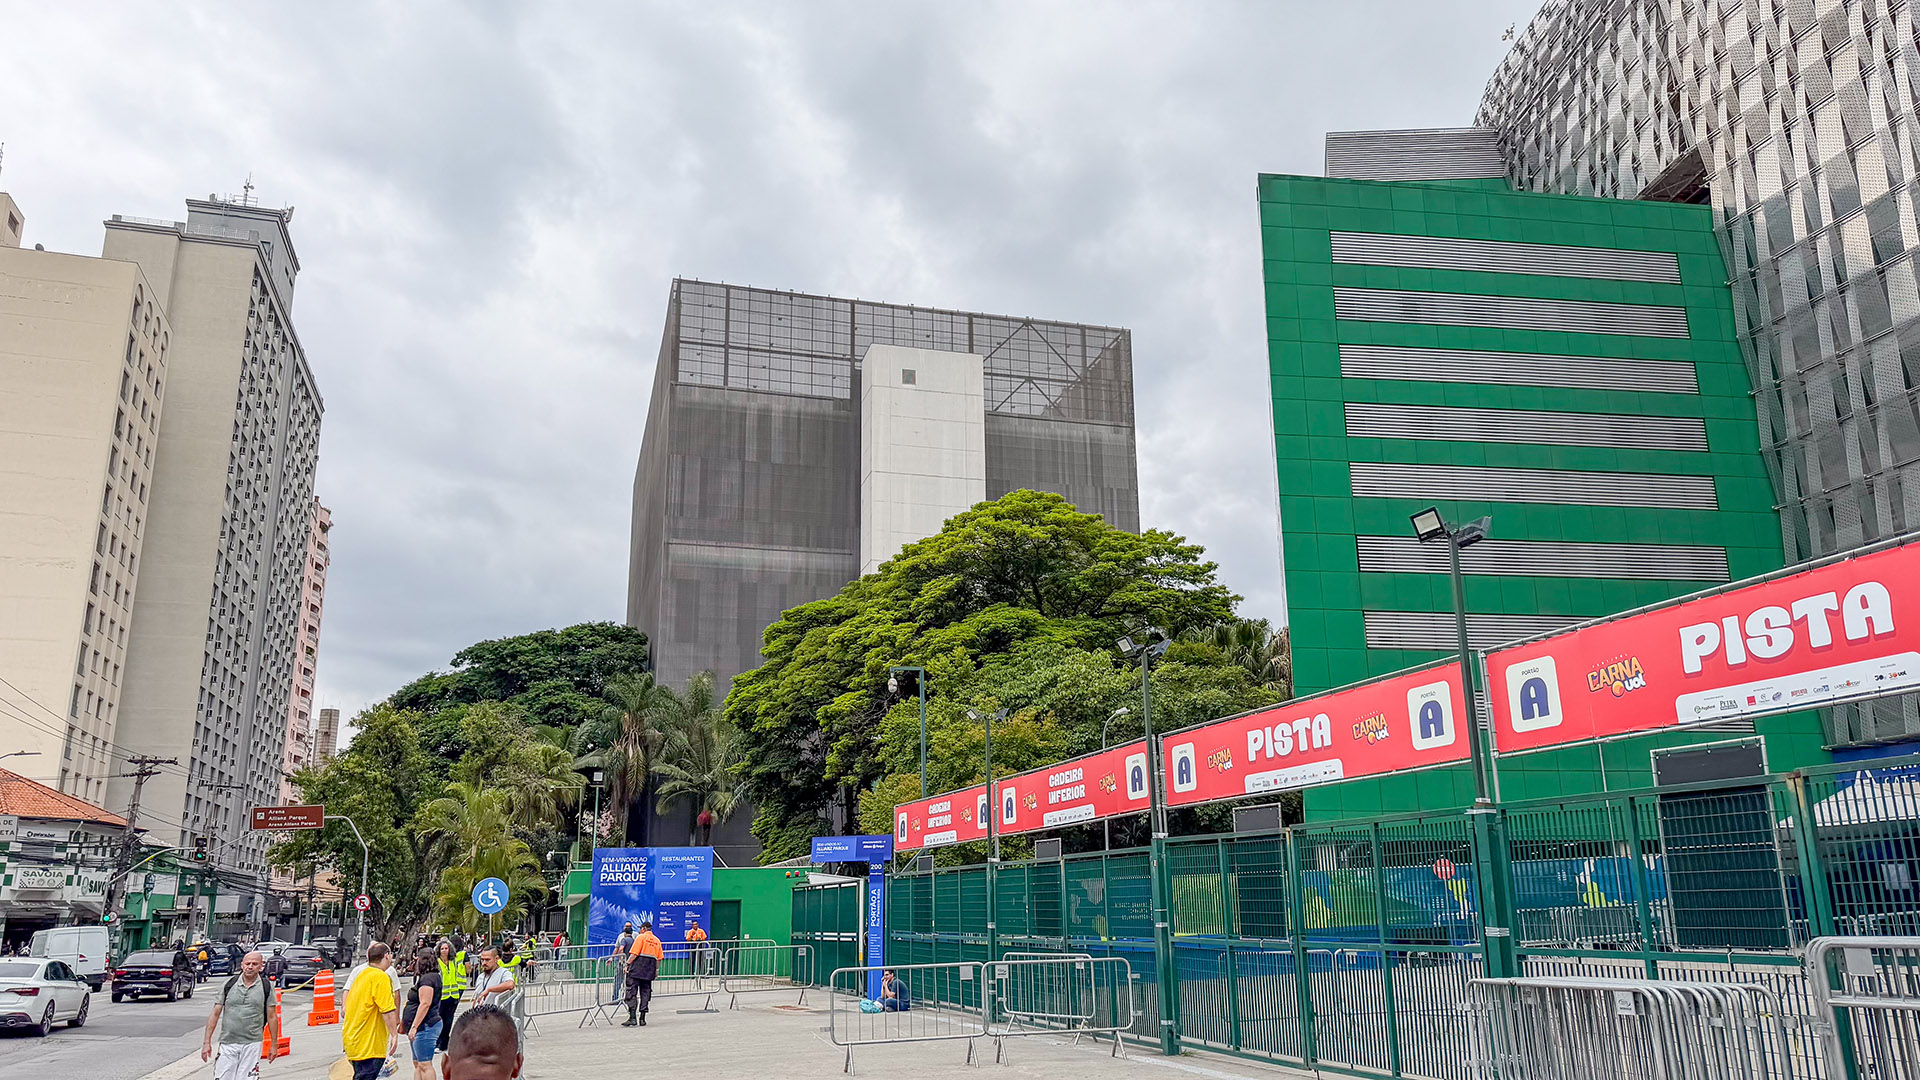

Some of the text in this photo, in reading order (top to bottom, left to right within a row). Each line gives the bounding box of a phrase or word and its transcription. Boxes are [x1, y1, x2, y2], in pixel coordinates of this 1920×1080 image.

[1679, 581, 1896, 675] PISTA
[1587, 656, 1645, 692] CARNA
[1520, 677, 1550, 720] A
[1353, 713, 1388, 740] CARNA
[1419, 700, 1444, 739] A
[1247, 713, 1332, 762] PISTA
[1049, 767, 1083, 788] CADEIRA
[1131, 765, 1143, 793] A
[1178, 755, 1191, 785] A
[1048, 784, 1085, 804] INFERIOR
[1005, 797, 1014, 819] A
[900, 820, 906, 838] A
[600, 872, 646, 882] PARQUE
[601, 863, 647, 872] ALLIANZ
